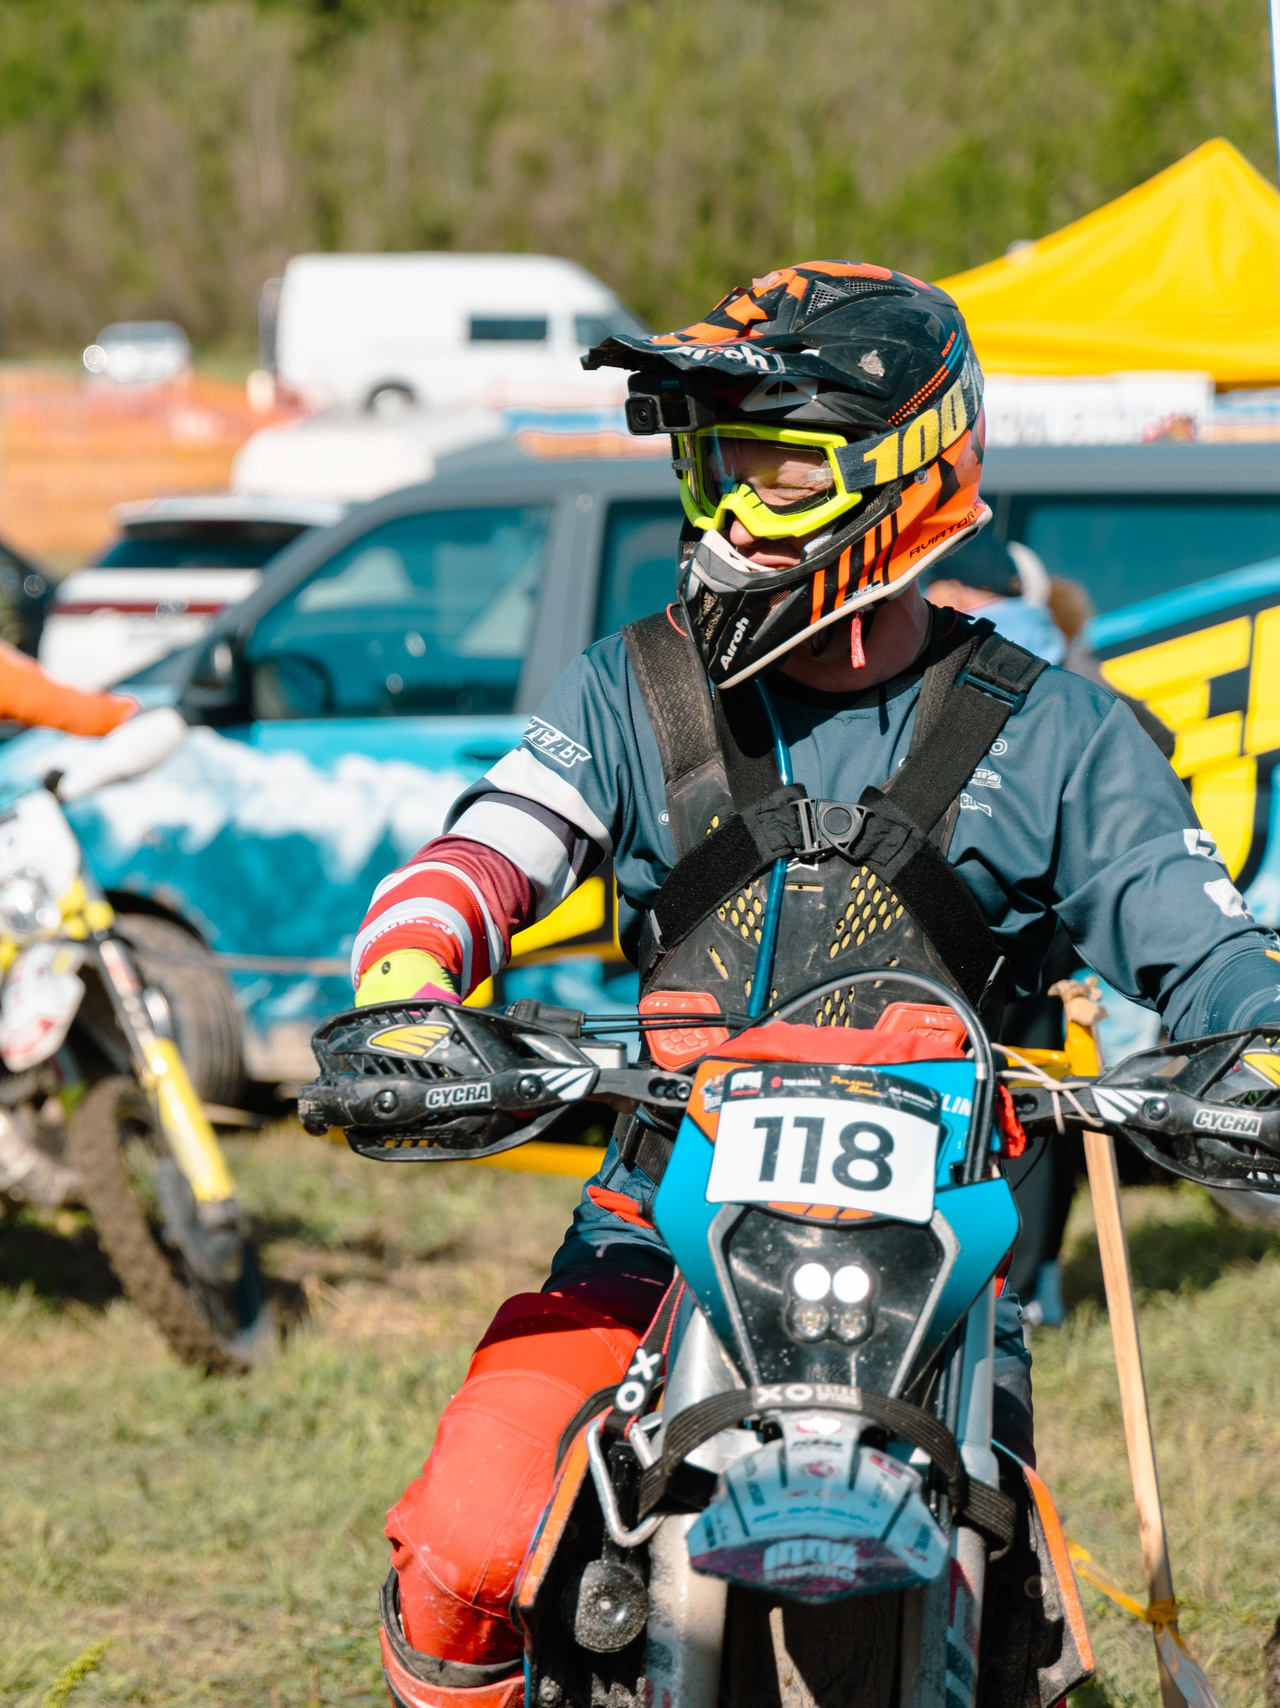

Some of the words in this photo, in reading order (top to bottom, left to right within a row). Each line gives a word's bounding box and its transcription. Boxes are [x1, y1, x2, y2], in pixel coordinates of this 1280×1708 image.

[909, 510, 976, 559] AVIATOR
[720, 616, 750, 671] Airoh
[428, 1085, 489, 1107] CYCRA
[1195, 1110, 1259, 1134] CYCRA
[753, 1115, 895, 1192] 118
[756, 1384, 814, 1404] XO
